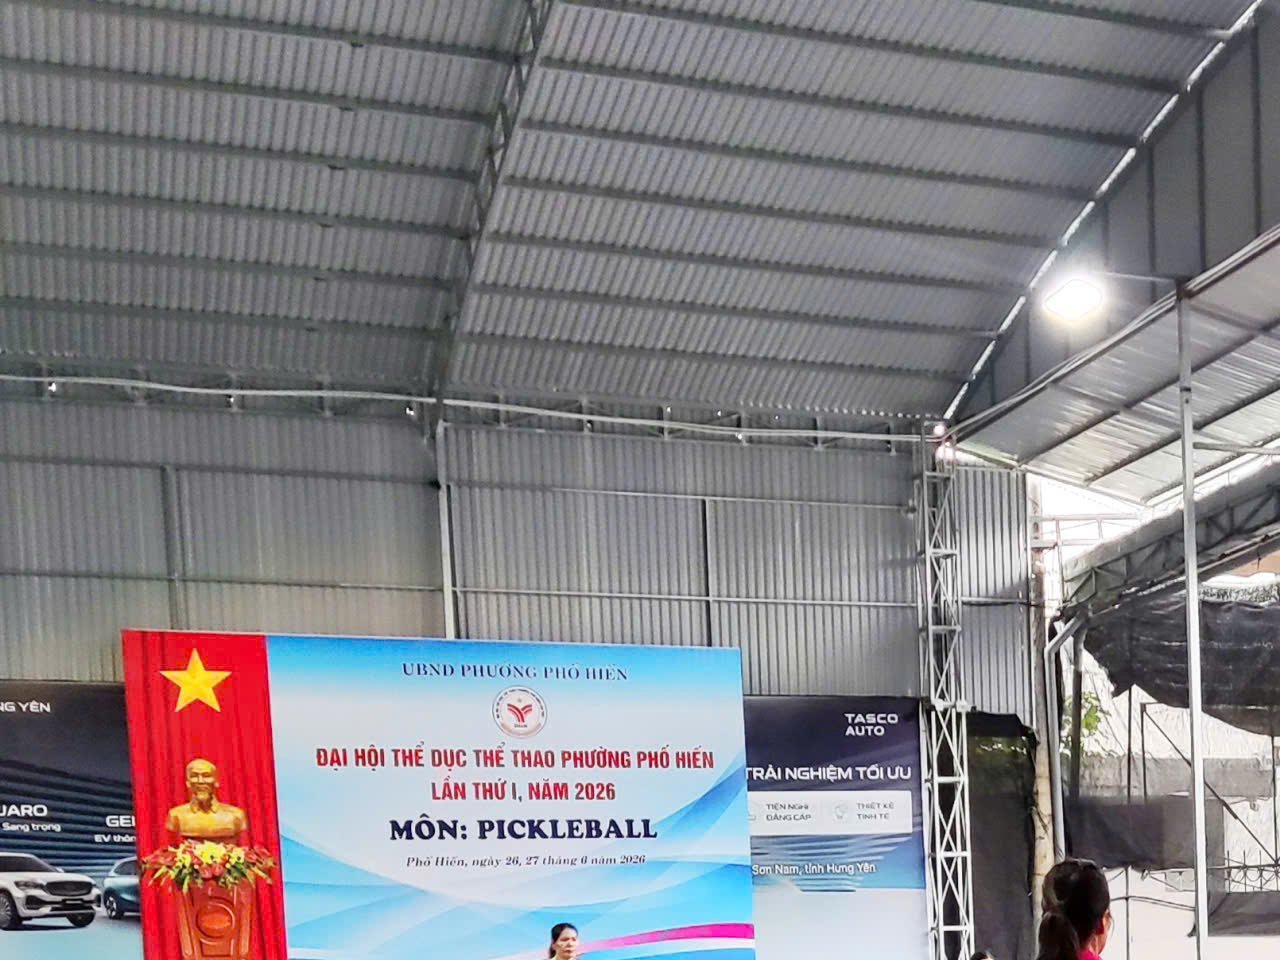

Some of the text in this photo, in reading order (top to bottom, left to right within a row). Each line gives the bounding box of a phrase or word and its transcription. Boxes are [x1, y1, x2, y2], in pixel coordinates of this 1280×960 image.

[402, 663, 454, 677] UBND
[18, 700, 51, 713] YÊN
[844, 713, 899, 724] TASCO
[845, 726, 885, 736] AUTO
[316, 741, 715, 772] ĐẠI HỘI THỂ DỤC THỂ THAO PHƯỜNG PHỐ HIẾN
[745, 764, 912, 782] TRẢI NGHIỆM TỐI ƯU
[431, 775, 616, 802] LẦN THỨ I, NĂM 2026
[2, 822, 30, 832] Sang
[389, 813, 658, 840] MÔN: PICKLEBALL
[94, 834, 111, 843] EV
[406, 855, 433, 867] Phố
[472, 856, 501, 868] ngày
[505, 856, 522, 867] 26,
[525, 856, 539, 865] 27
[543, 856, 577, 866] tháng
[620, 854, 646, 864] 2026
[751, 863, 876, 876] Sơn Nam, tỉnh Hưng Yên
